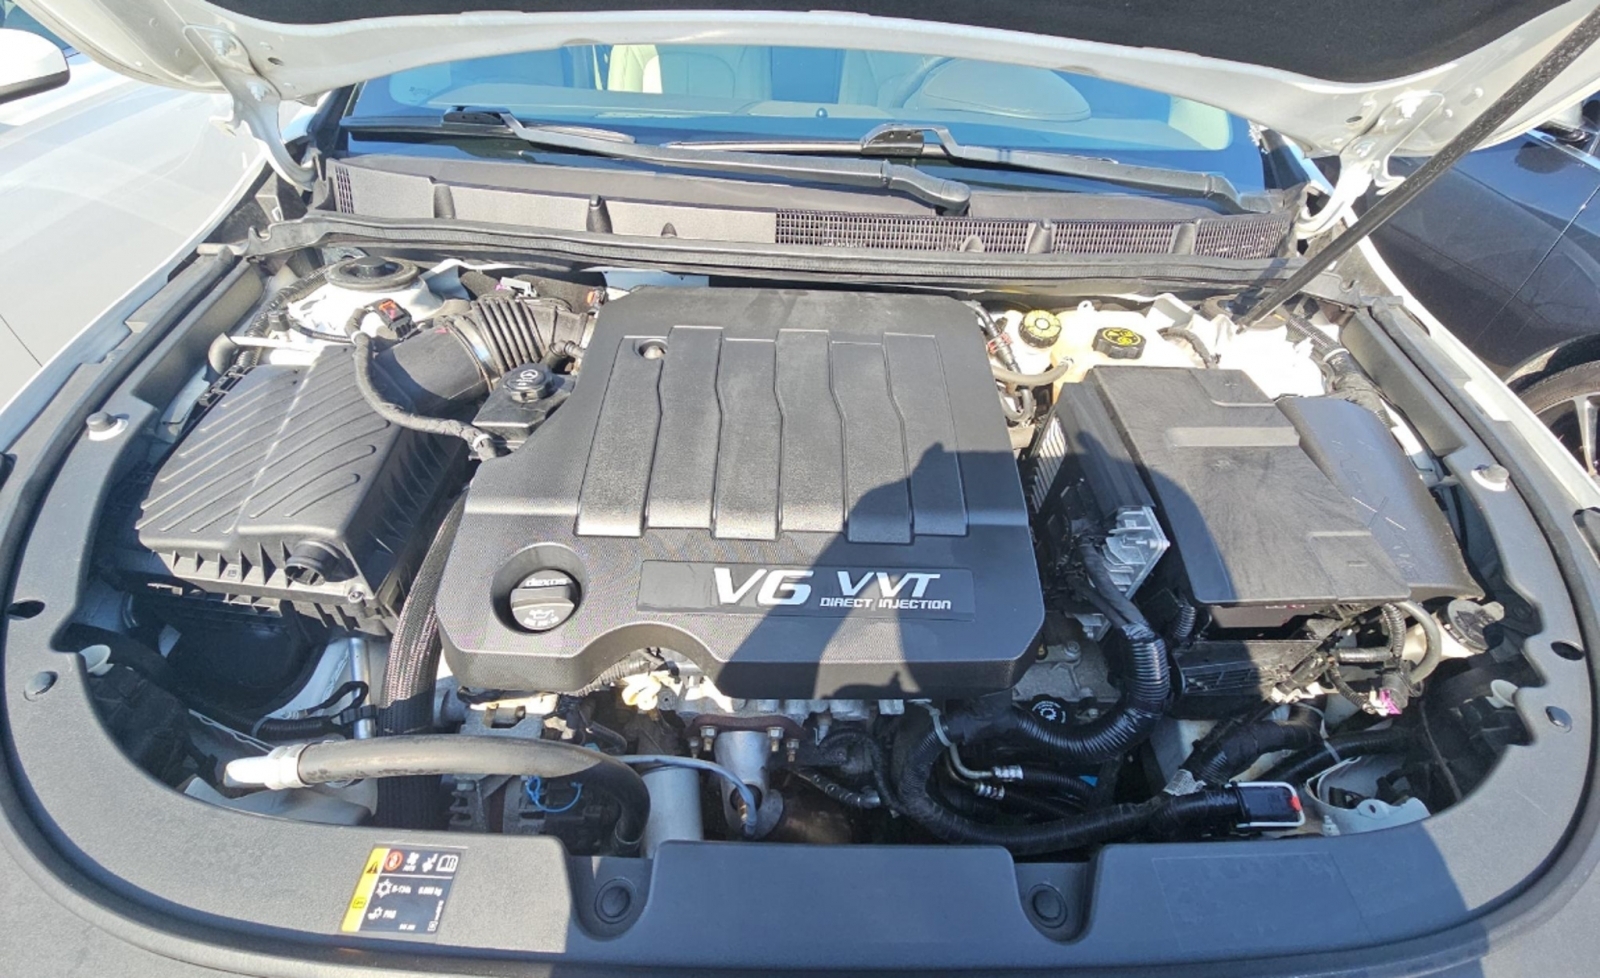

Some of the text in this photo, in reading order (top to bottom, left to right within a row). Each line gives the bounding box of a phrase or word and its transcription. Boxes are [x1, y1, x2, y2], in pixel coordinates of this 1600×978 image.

[713, 567, 940, 605] V6 VVT
[820, 597, 951, 610] DIRECT INJECTION
